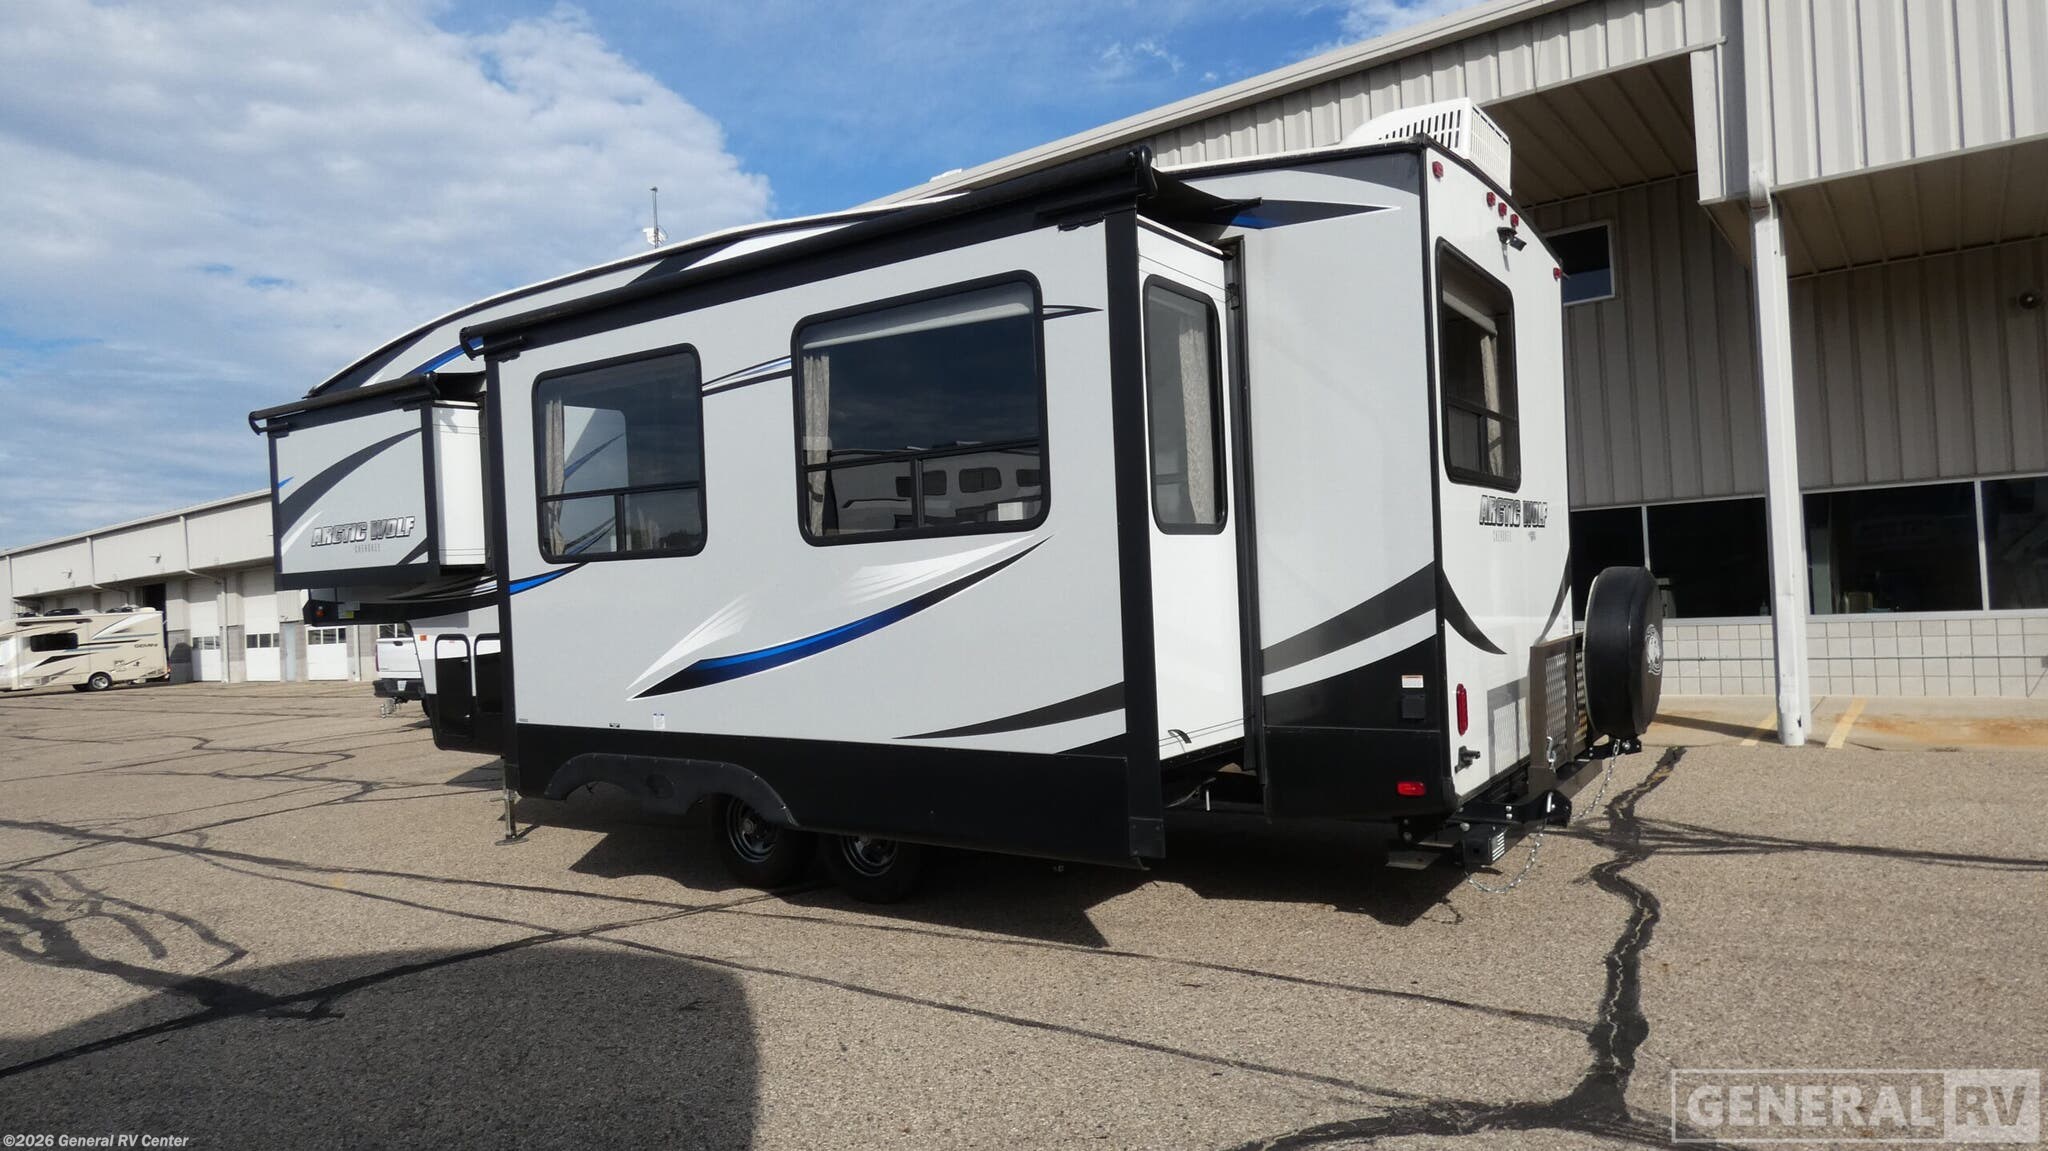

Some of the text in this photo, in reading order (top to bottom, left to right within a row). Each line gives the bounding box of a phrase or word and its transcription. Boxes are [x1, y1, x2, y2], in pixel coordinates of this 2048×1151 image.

[1479, 494, 1548, 528] ARCTIC WOLF
[311, 516, 415, 547] ARCTIC WOLF
